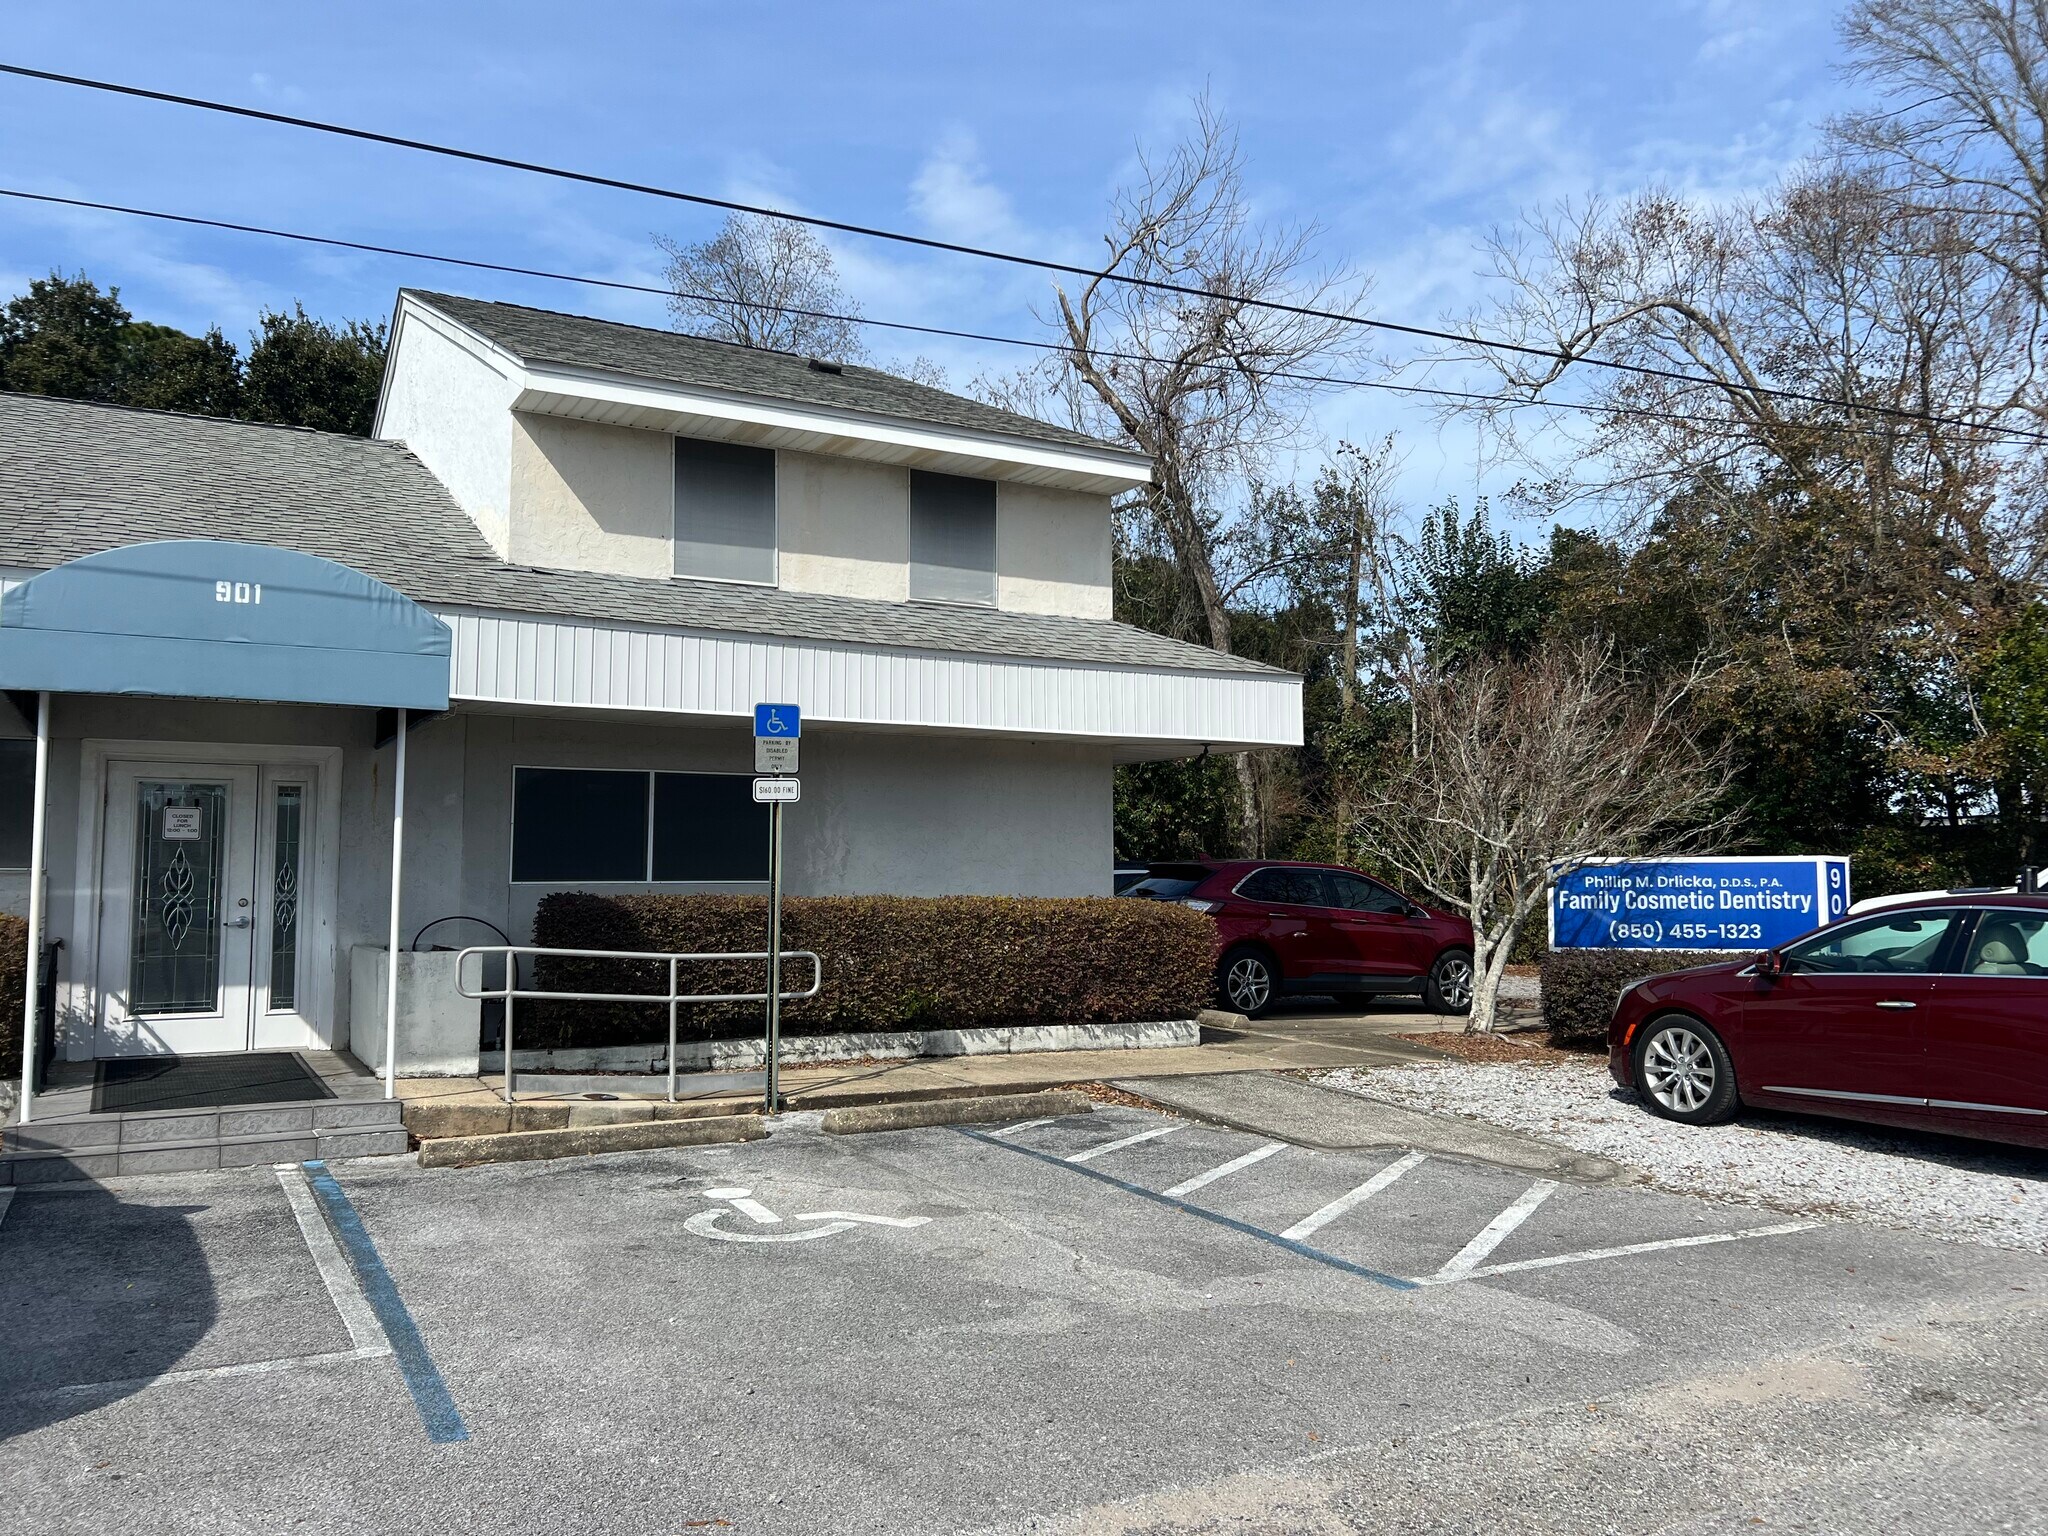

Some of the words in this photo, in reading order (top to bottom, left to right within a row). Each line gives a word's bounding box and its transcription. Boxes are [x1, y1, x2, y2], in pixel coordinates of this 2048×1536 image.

[216, 581, 261, 604] 901
[1585, 876, 1631, 891] Phillip
[1636, 876, 1654, 888] M.
[1657, 876, 1716, 889] Drlicka,
[1720, 878, 1757, 889] D.D.S.,
[1760, 878, 1783, 888] P.A.
[1559, 890, 1620, 913] Family
[1625, 890, 1714, 910] Cosmetic
[1720, 890, 1812, 913] Dentistry
[1609, 920, 1663, 941] (850)
[1669, 924, 1762, 939] 455-1323
